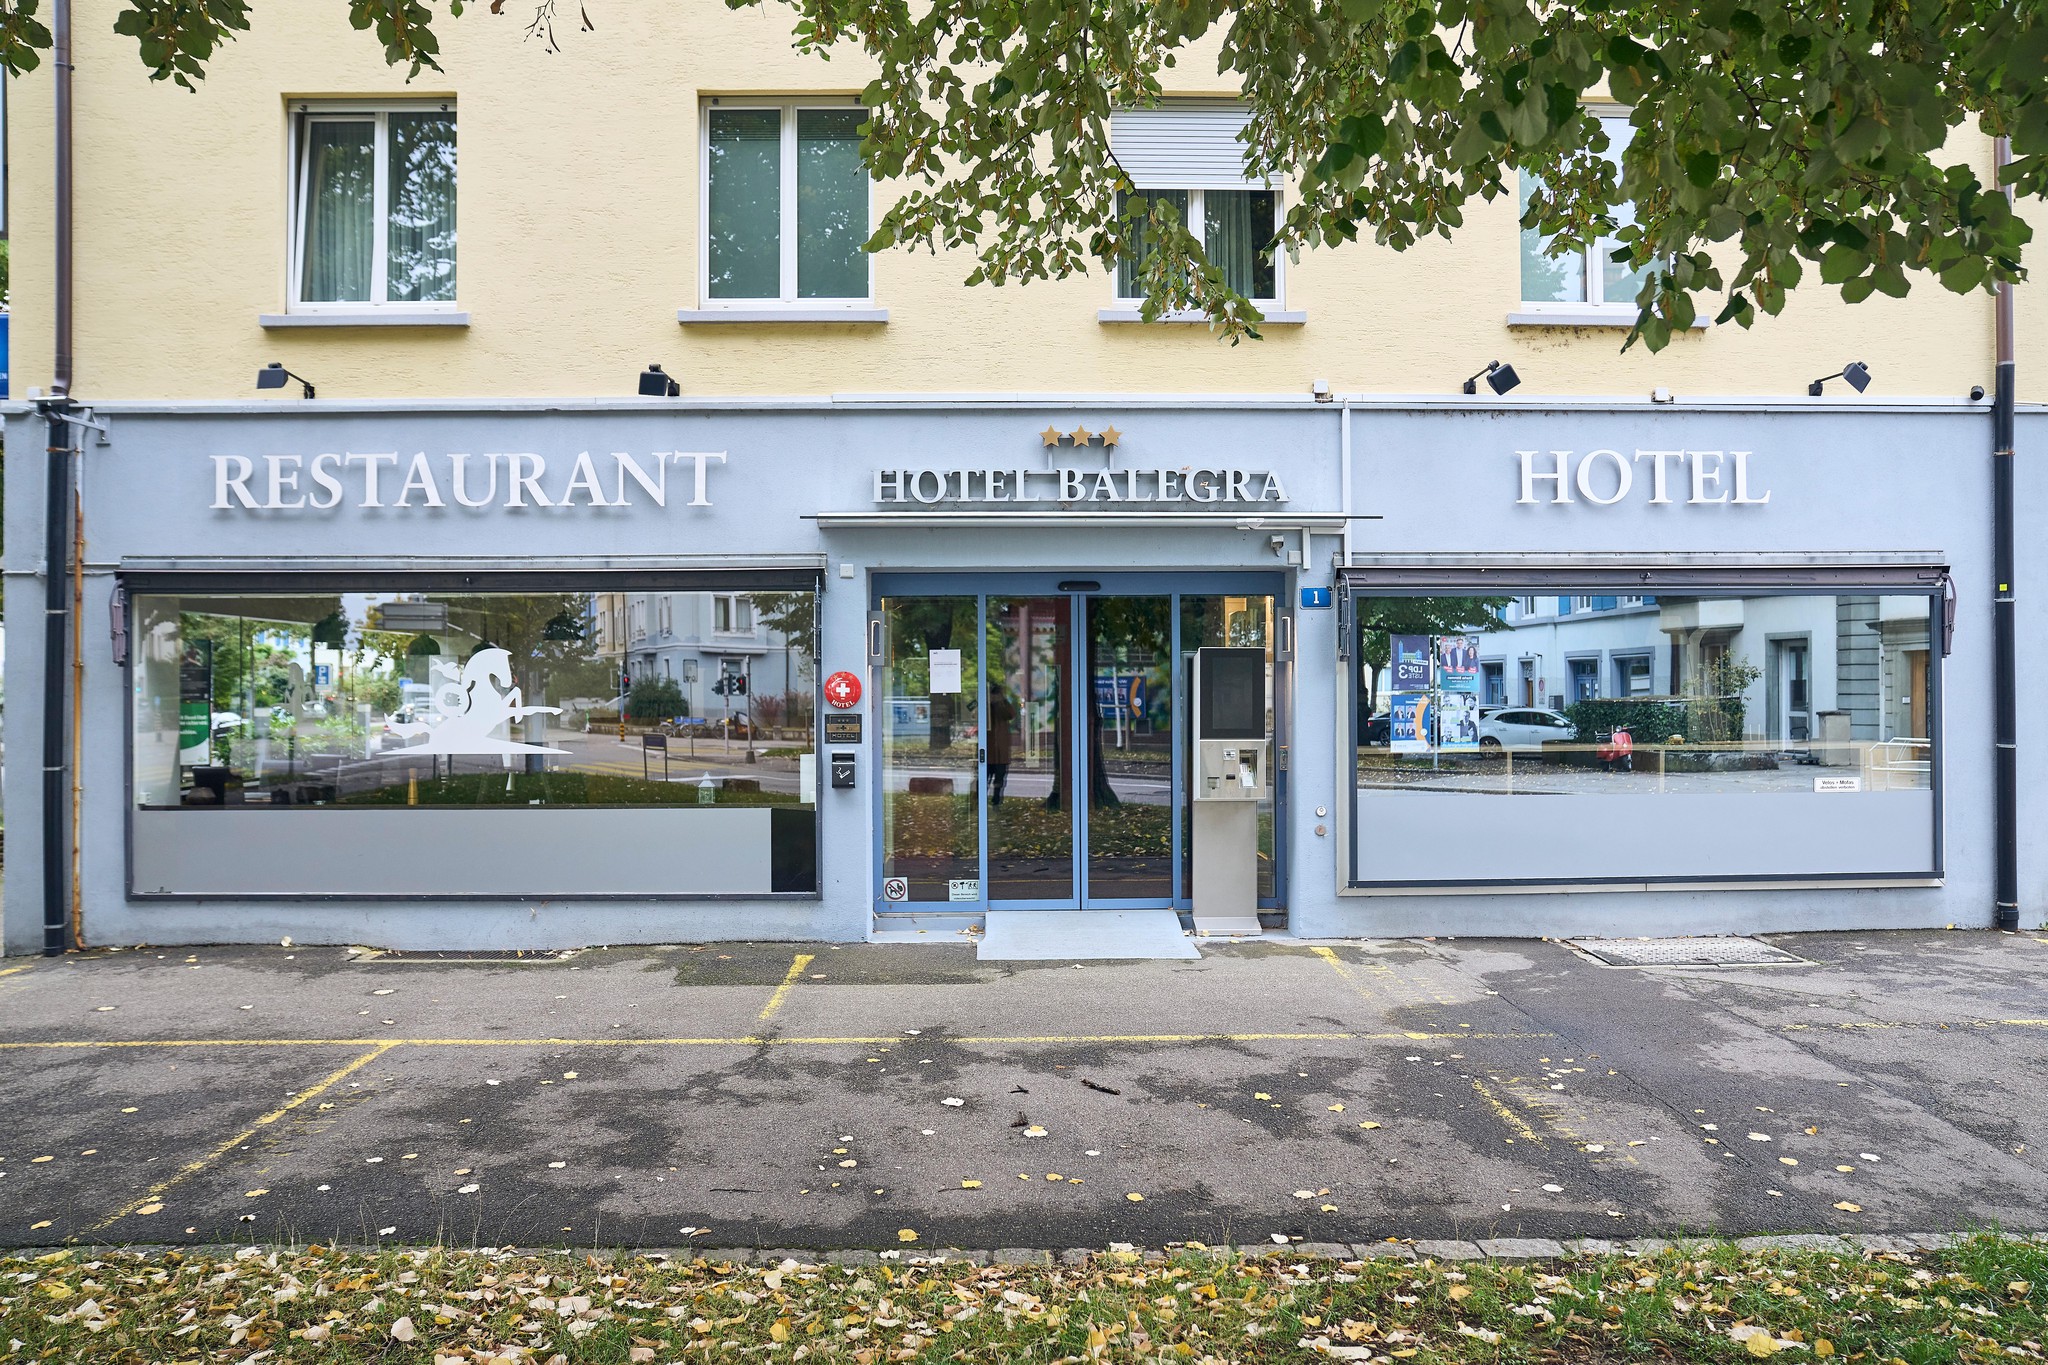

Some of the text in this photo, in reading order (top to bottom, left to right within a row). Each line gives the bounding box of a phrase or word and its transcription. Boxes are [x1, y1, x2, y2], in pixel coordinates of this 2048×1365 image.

[208, 450, 728, 508] RESTAURANT
[871, 466, 1291, 503] HOTEL BALEGRA
[1514, 448, 1771, 505] HOTEL
[1313, 590, 1320, 604] 1
[831, 699, 855, 708] HOTEL
